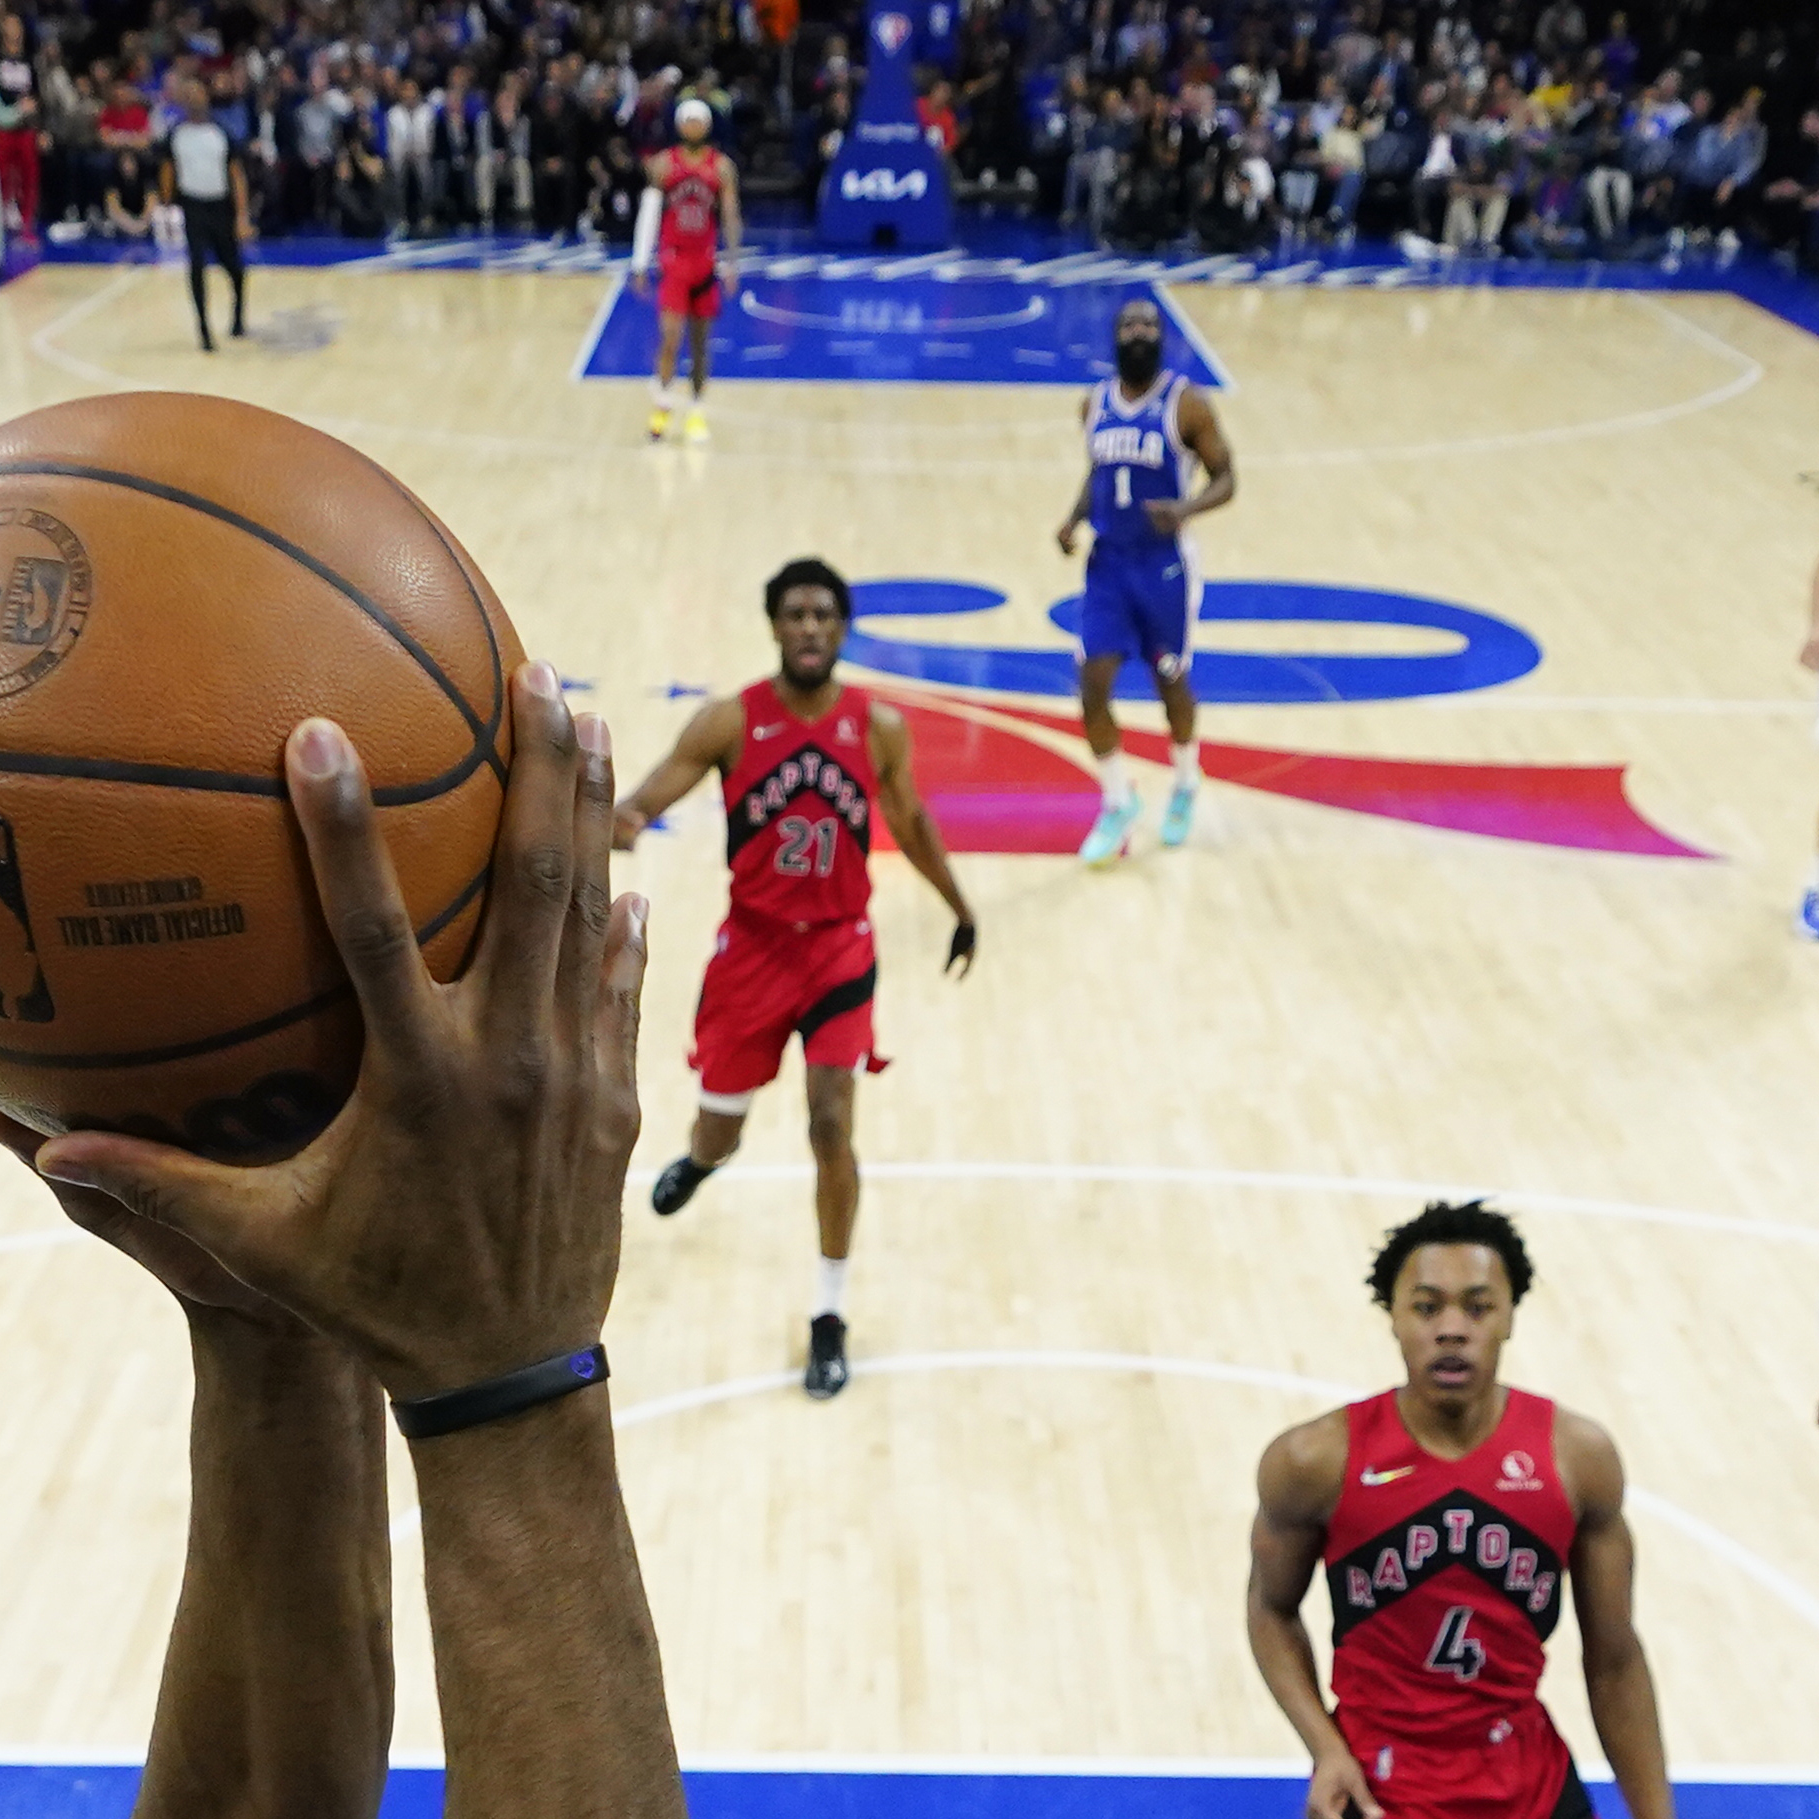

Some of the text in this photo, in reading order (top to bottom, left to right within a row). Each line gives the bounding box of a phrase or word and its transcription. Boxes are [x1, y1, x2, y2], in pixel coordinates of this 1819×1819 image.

[1114, 465, 1133, 510] 1
[745, 751, 868, 830] RAPTORS
[774, 815, 839, 878] 21
[1346, 1508, 1556, 1613] RAPTORS
[1423, 1605, 1487, 1683] 4
